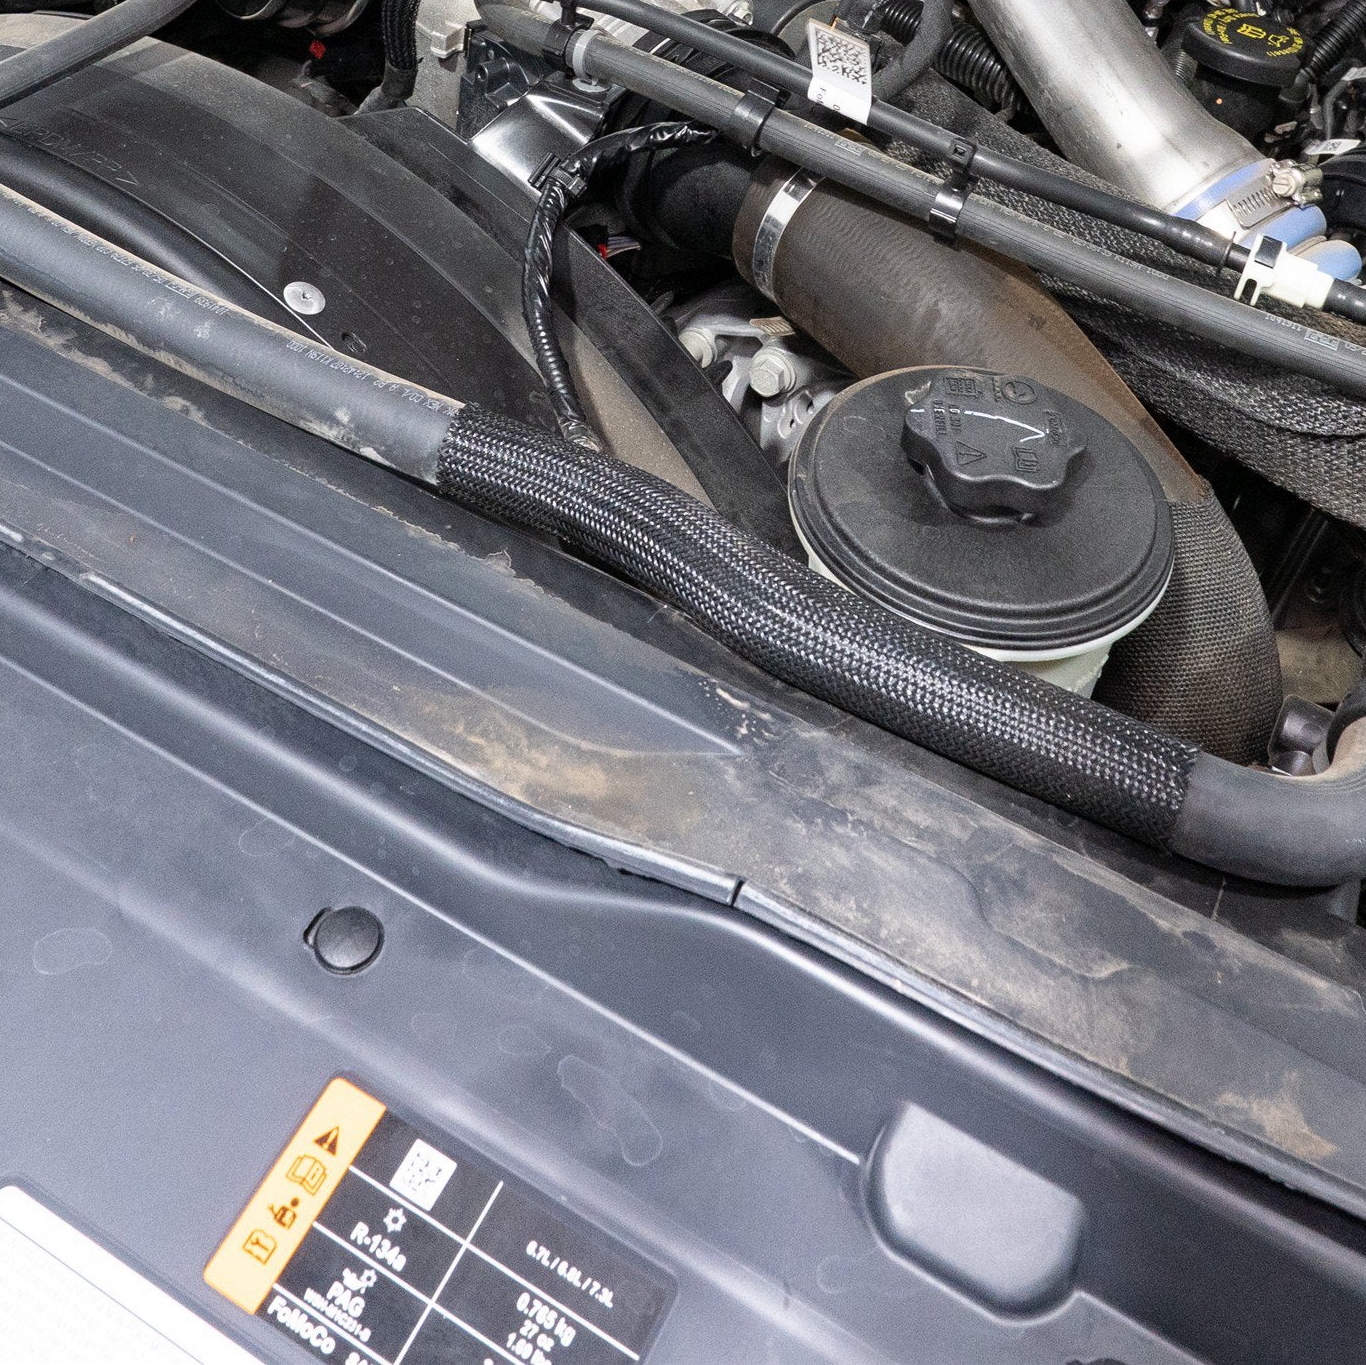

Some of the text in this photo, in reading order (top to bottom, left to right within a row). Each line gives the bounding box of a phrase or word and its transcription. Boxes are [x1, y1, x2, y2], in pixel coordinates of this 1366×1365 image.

[349, 1222, 406, 1271] R-134a
[323, 1281, 365, 1318] PAG
[517, 1292, 576, 1347] 0.765 kg
[267, 1295, 336, 1354] FoMoCo
[520, 1319, 539, 1339] 27
